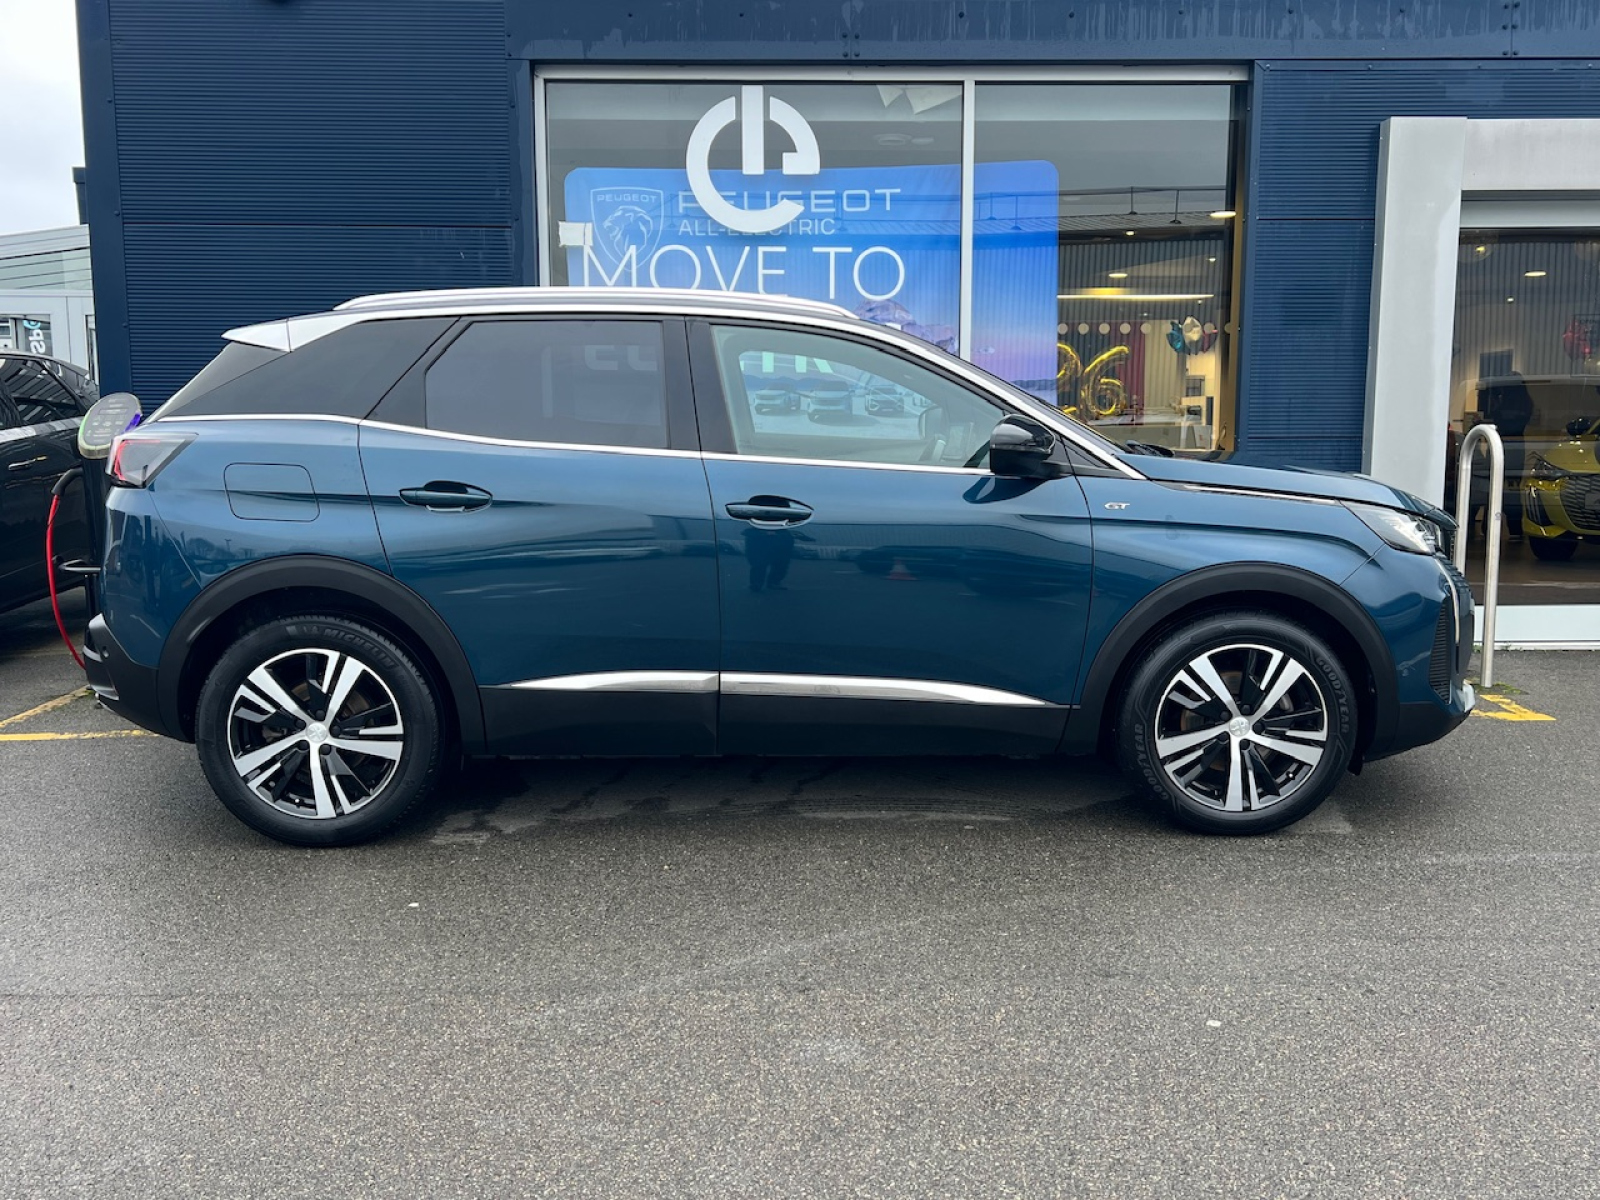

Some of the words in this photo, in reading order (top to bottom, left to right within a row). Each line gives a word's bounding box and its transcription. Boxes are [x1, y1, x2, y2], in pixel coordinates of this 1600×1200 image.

[597, 193, 657, 203] PEUGEOT
[678, 218, 836, 236] ALL-TRIC
[583, 244, 788, 297] MOVE
[812, 245, 906, 301] TO
[1104, 501, 1131, 511] GT
[324, 629, 396, 667] MICHELIN
[1315, 657, 1350, 733] GOODYEAR
